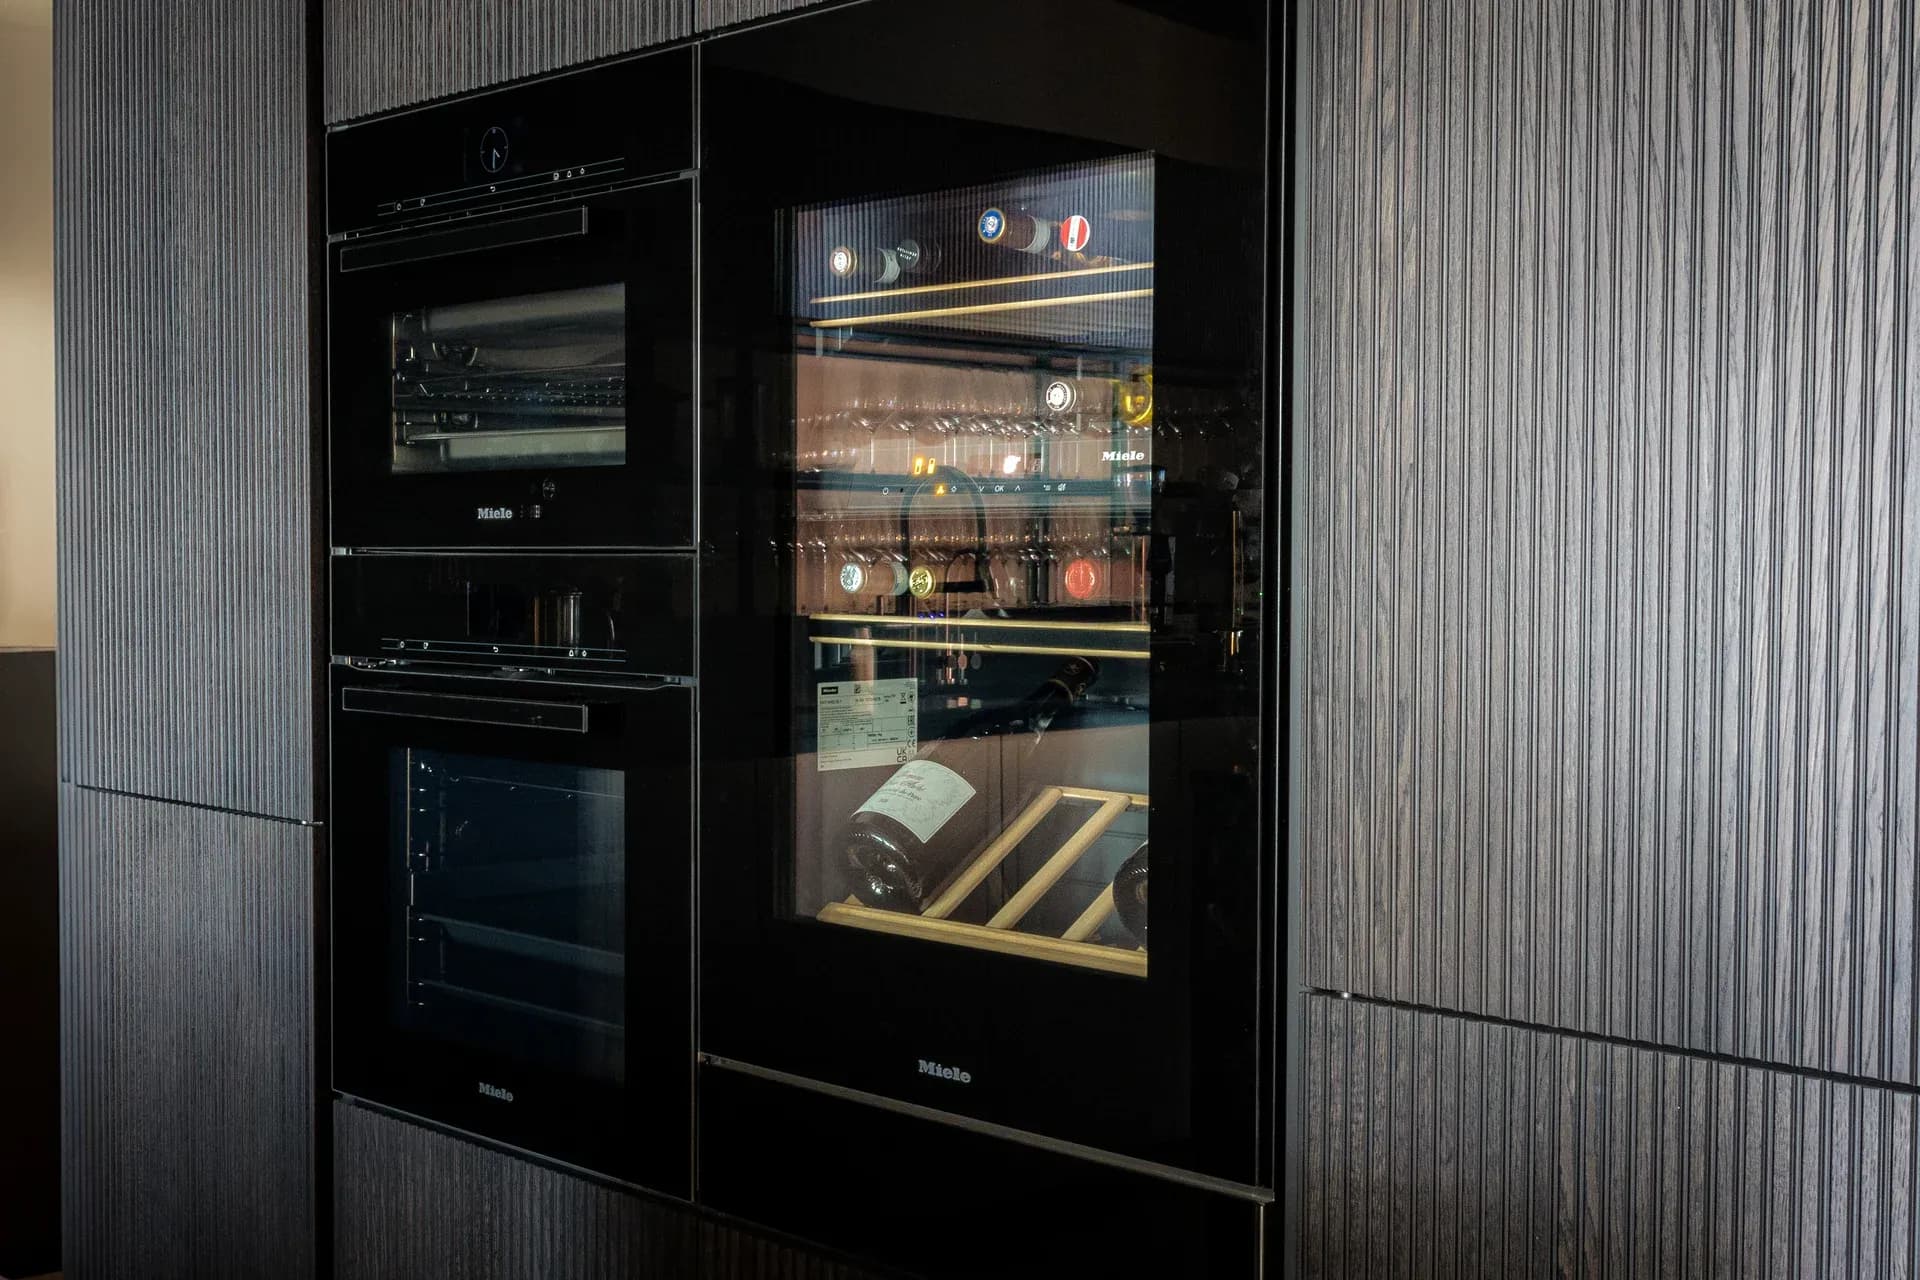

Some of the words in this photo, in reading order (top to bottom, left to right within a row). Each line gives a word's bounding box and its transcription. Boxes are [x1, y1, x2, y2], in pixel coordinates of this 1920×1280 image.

[1102, 450, 1145, 461] Miele
[994, 485, 1005, 493] OK
[478, 507, 513, 519] Miele
[918, 1059, 971, 1083] Miele
[479, 1081, 514, 1102] Miele
